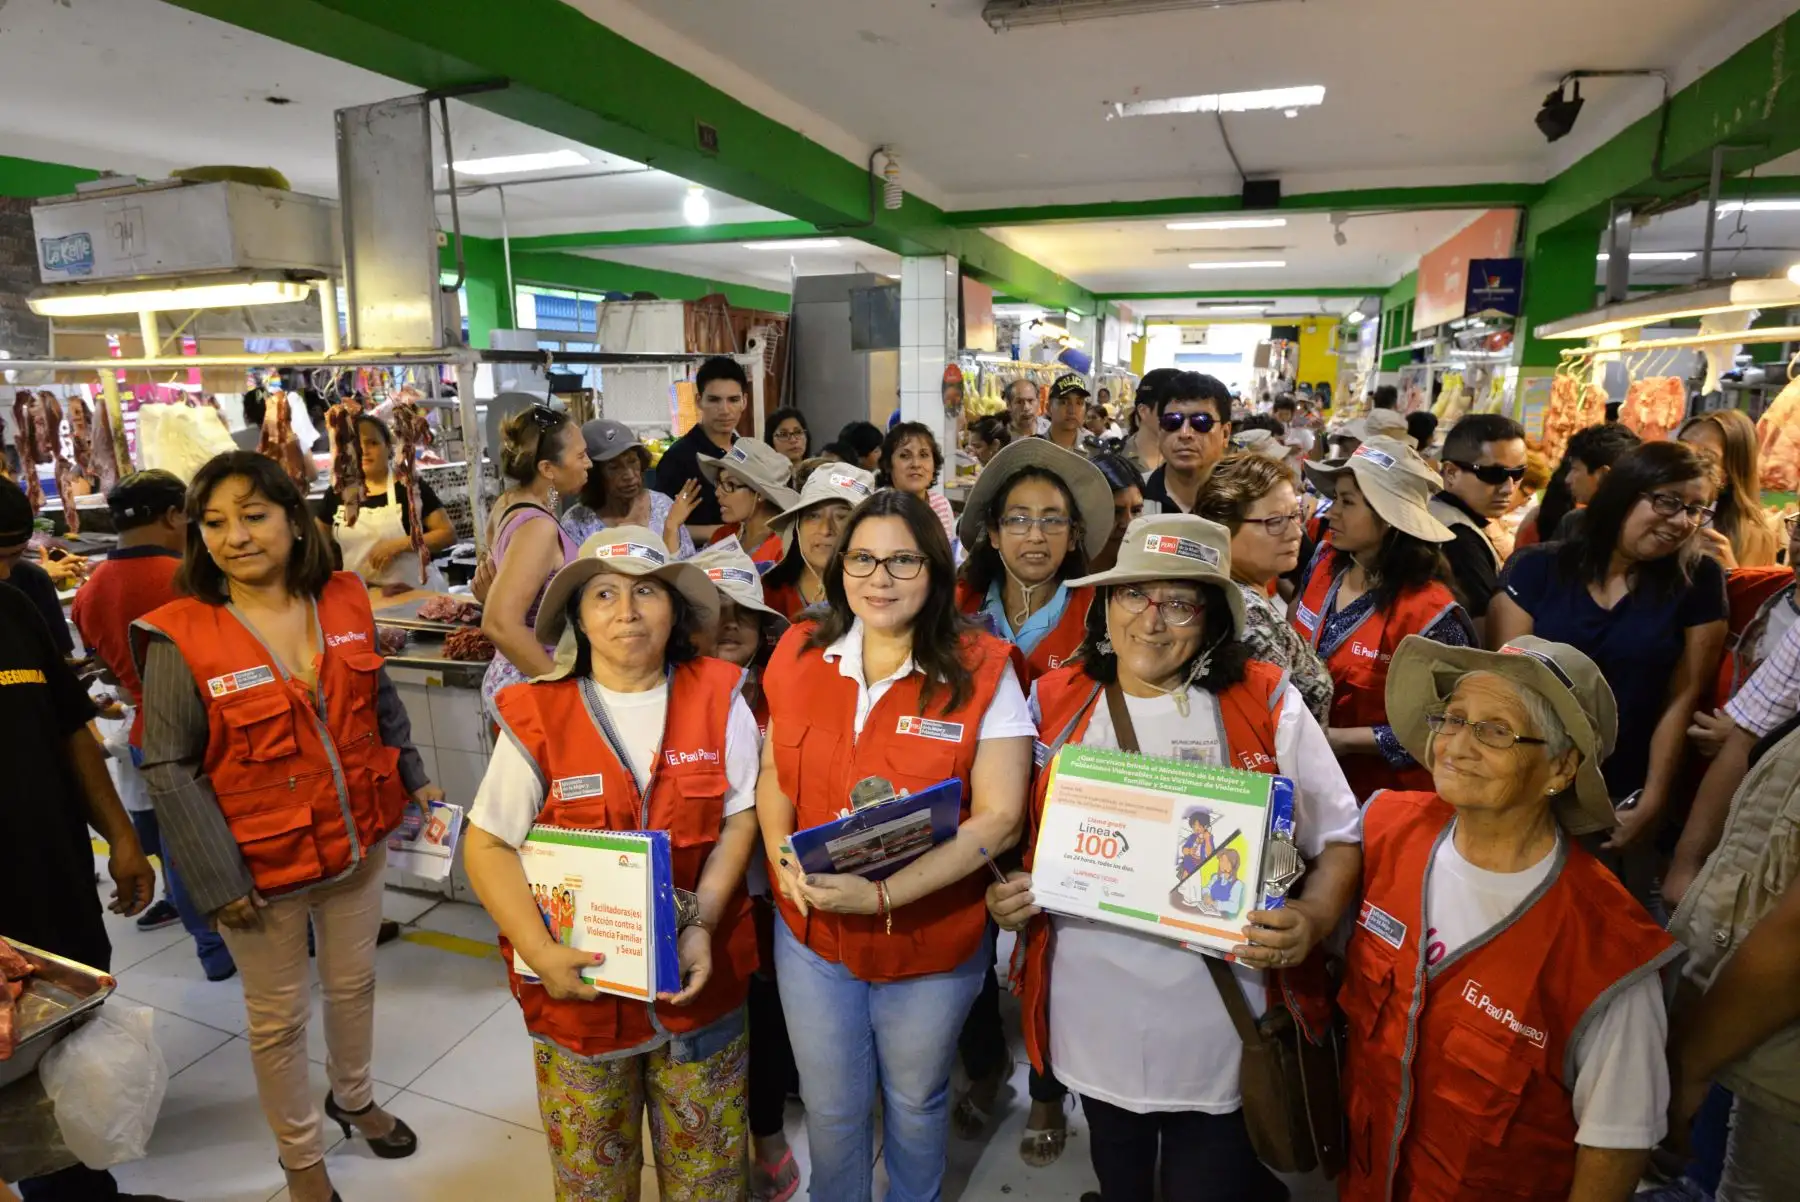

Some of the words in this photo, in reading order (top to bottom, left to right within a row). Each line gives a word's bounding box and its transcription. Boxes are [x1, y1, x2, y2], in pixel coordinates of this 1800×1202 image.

[1113, 766, 1153, 780] Vulnerables
[1215, 781, 1250, 795] Violencia
[1159, 766, 1196, 778] Ministerio
[1216, 774, 1238, 786] Mujer
[1239, 778, 1247, 787] y
[1079, 821, 1110, 837] Línea
[1074, 832, 1118, 859] 100
[583, 914, 592, 922] en
[592, 914, 614, 928] Acción
[614, 919, 635, 930] contra
[635, 922, 642, 931] la
[587, 926, 616, 940] Violencia
[616, 929, 642, 944] Familiar
[616, 945, 621, 955] y
[621, 944, 642, 956] Sexual
[1465, 986, 1478, 1007] EL
[1477, 994, 1504, 1021] PERÚ
[1501, 1009, 1544, 1041] PRIMERO
